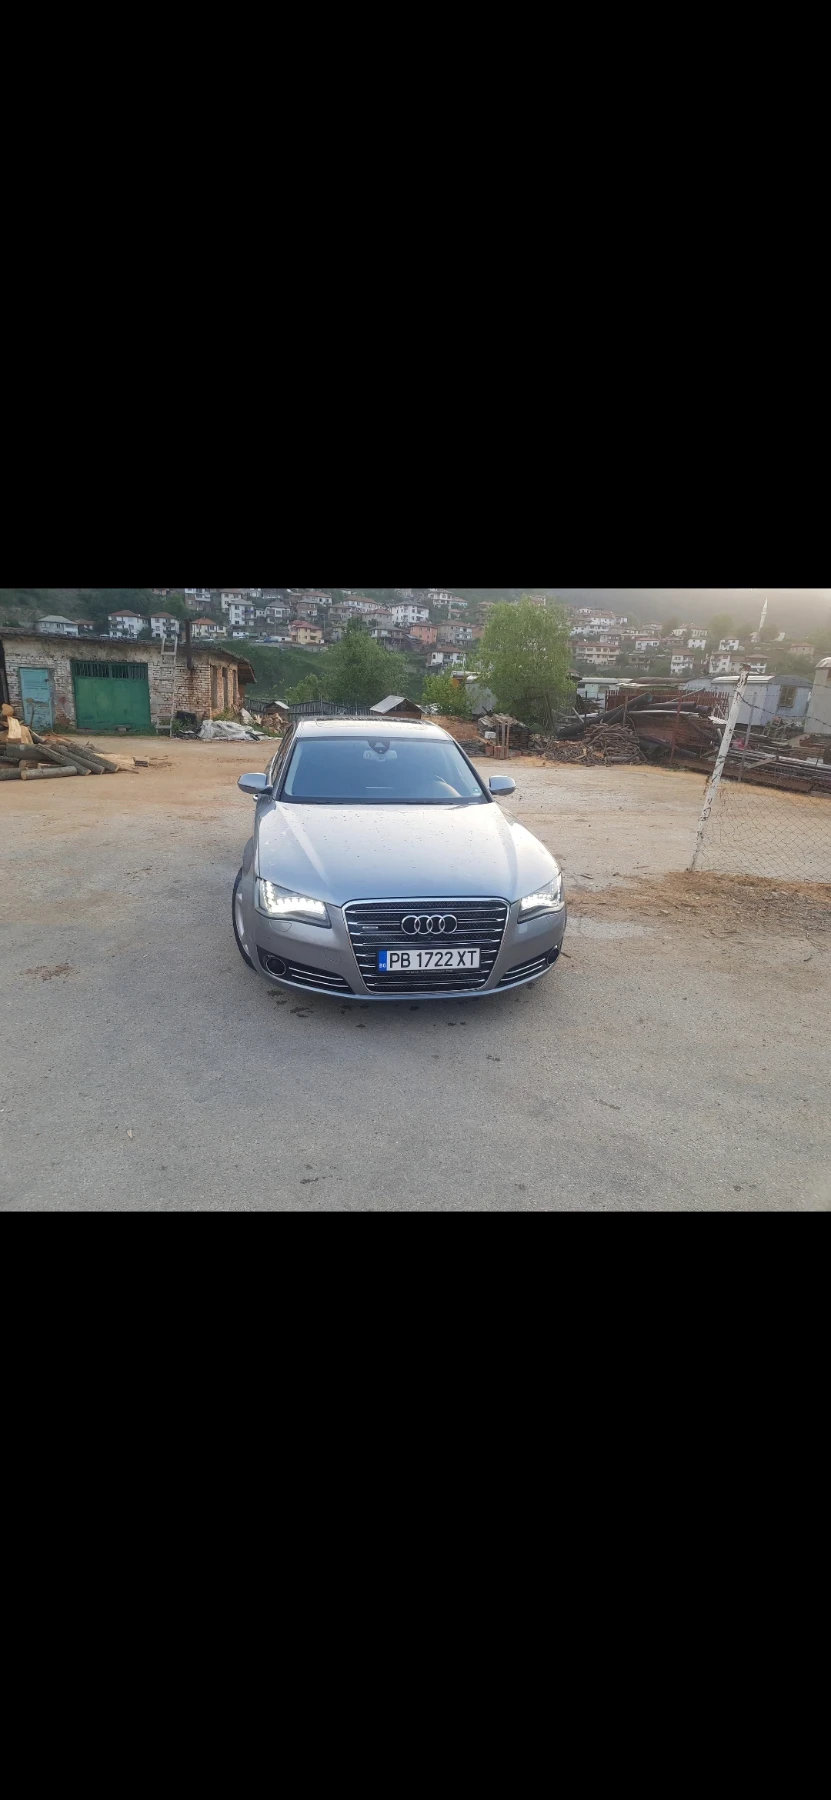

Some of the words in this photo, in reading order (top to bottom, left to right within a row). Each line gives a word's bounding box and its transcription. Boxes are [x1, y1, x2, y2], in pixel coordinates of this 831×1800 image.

[389, 952, 411, 969] PB
[416, 951, 454, 968] 1722
[457, 950, 478, 967] XT
